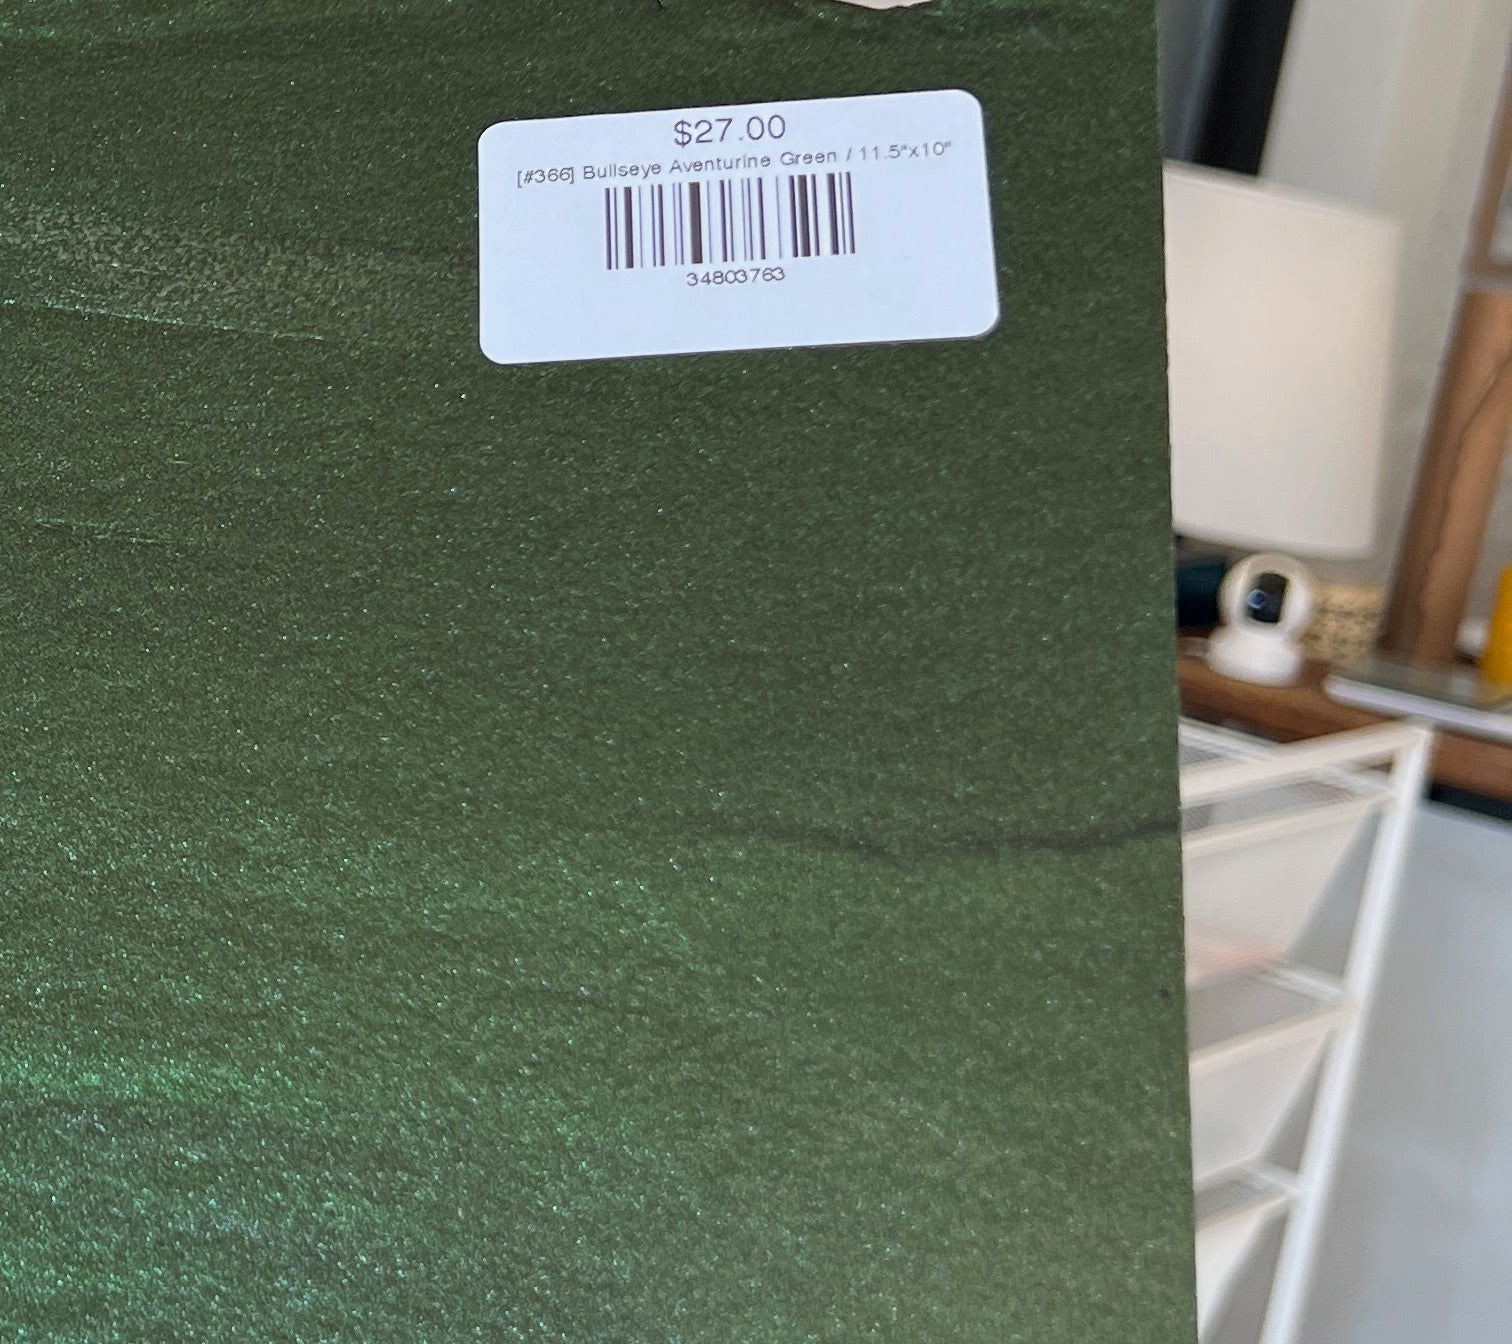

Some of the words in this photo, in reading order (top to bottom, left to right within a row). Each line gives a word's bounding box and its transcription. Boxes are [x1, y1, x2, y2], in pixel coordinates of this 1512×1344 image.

[673, 114, 786, 147] $27.00
[516, 166, 575, 188] [#366]
[582, 161, 662, 180] Bullseye
[669, 154, 771, 174] Aventurine
[779, 151, 837, 166] Green
[845, 147, 853, 162] /
[685, 267, 786, 287] 34803763
